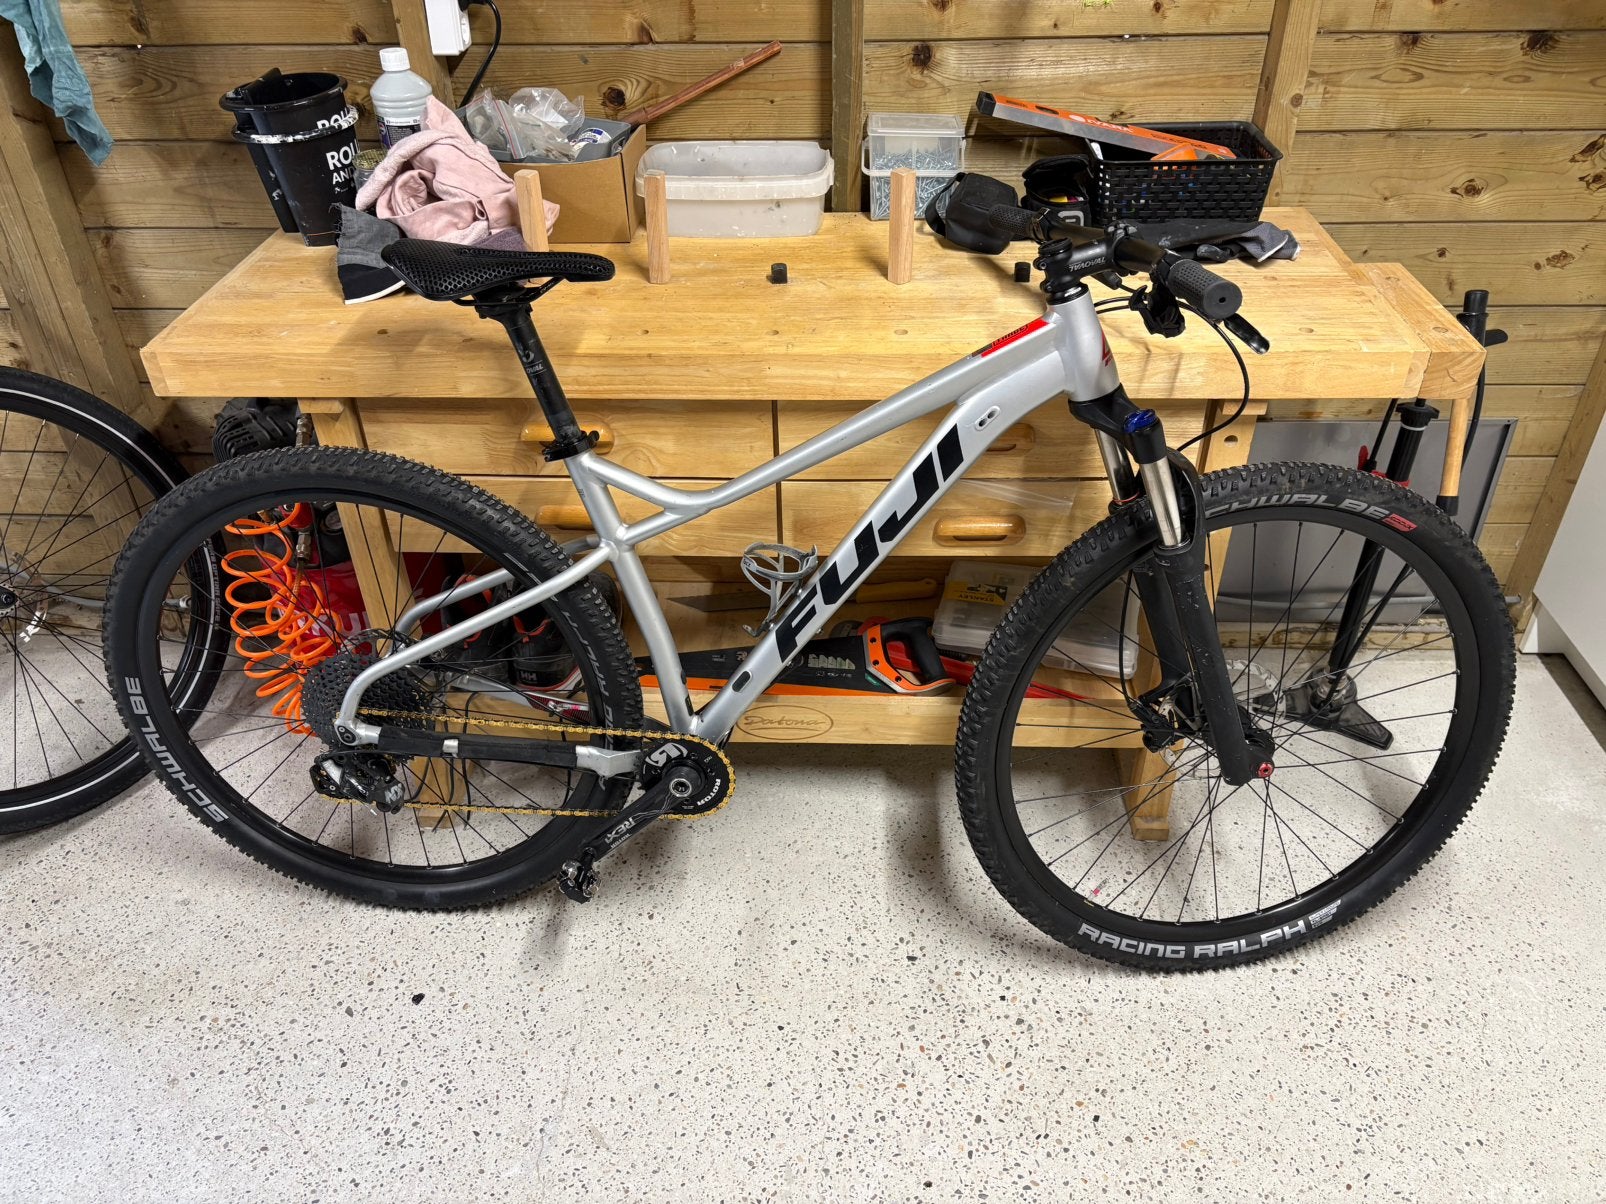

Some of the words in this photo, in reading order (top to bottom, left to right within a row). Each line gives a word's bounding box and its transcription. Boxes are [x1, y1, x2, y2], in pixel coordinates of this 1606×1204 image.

[1205, 493, 1390, 520] CHWALBE
[776, 423, 964, 664] FUJI
[743, 715, 826, 726] Datona
[124, 676, 229, 823] SCHWALBE
[696, 779, 721, 806] ROTOR
[1077, 922, 1186, 959] RACING
[1193, 918, 1307, 959] RALPH
